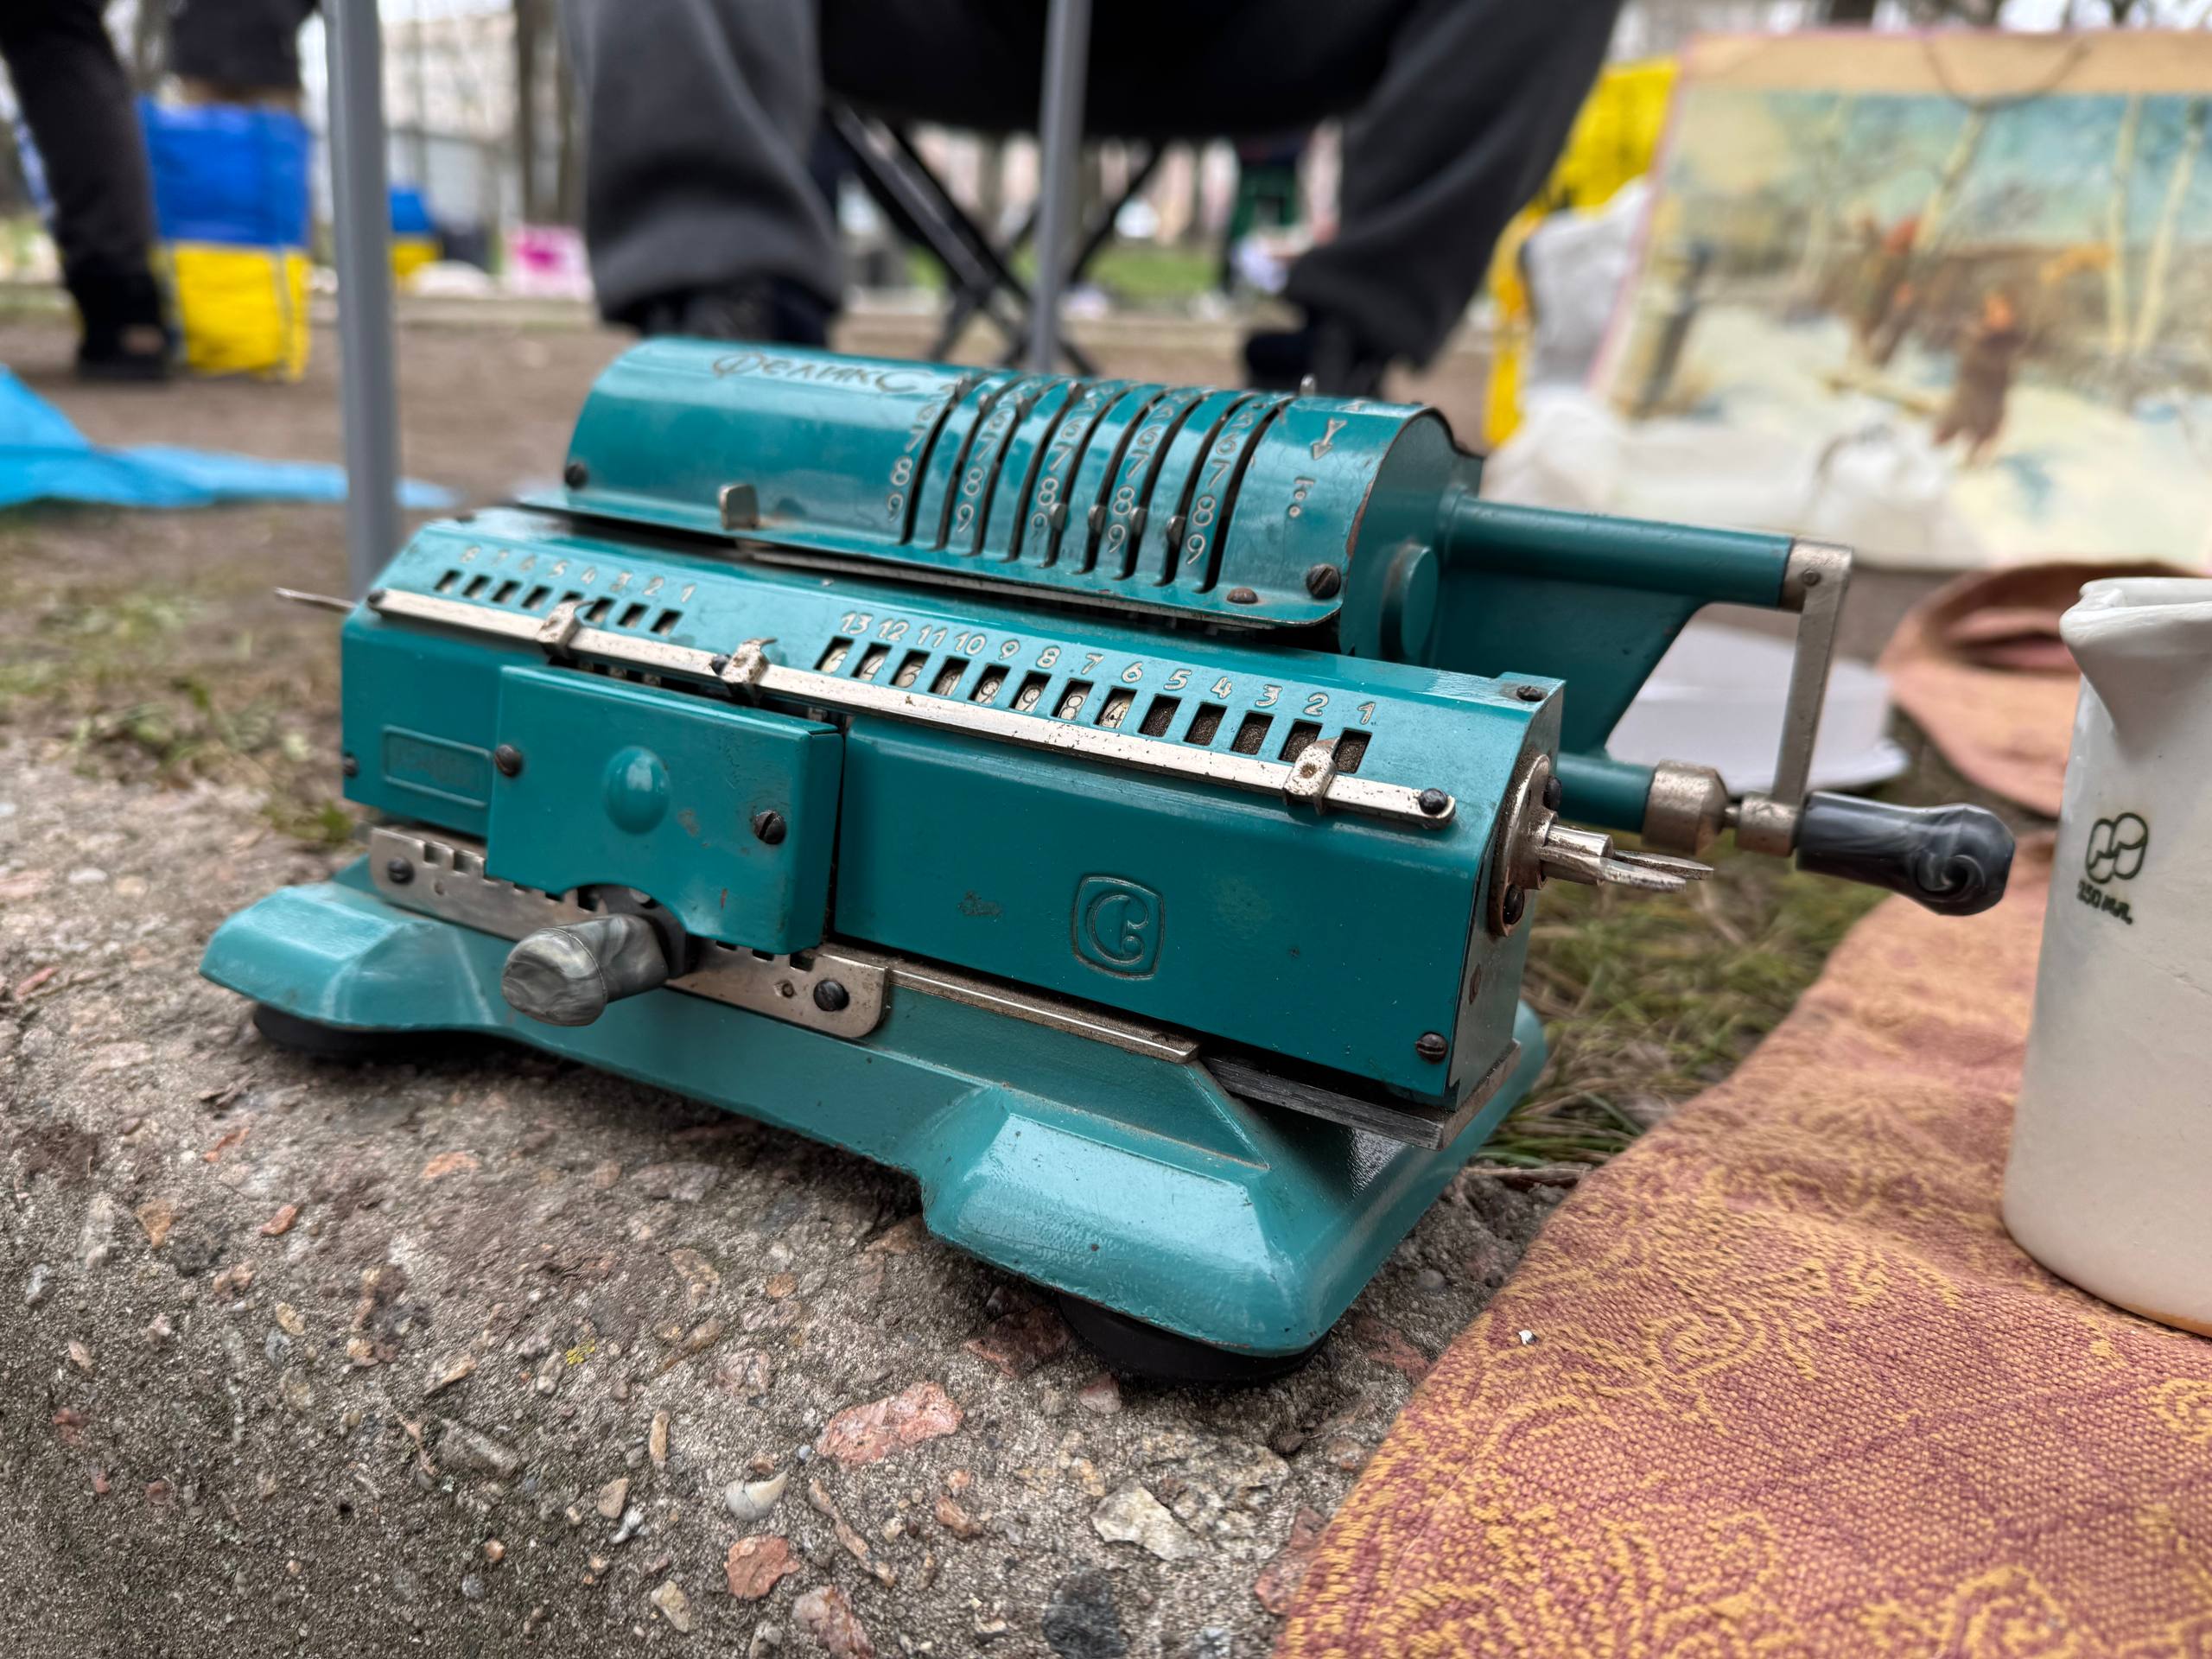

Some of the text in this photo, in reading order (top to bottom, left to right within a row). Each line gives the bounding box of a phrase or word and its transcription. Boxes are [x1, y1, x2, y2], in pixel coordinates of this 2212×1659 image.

[906, 424, 924, 453] 7
[1061, 418, 1084, 439] 6
[1136, 424, 1163, 444] 6
[976, 434, 997, 461] 7
[1050, 442, 1072, 471] 7
[1215, 433, 1237, 456] 6
[890, 455, 912, 486] 8
[1126, 449, 1149, 479] 7
[1208, 459, 1230, 488] 7
[963, 467, 984, 497] 8
[1038, 477, 1058, 506] 8
[887, 492, 904, 523] 9
[1113, 485, 1135, 515] 8
[1192, 496, 1216, 526] 8
[957, 503, 975, 533] 9
[1107, 524, 1126, 553] 9
[1185, 533, 1206, 565] 9
[610, 571, 633, 592] 3
[643, 575, 665, 596] 2
[681, 583, 696, 603] 1
[841, 611, 1376, 725] 13 12 11 10 9 8 7 6 5 4 3 2 1
[1060, 695, 1084, 720] 8
